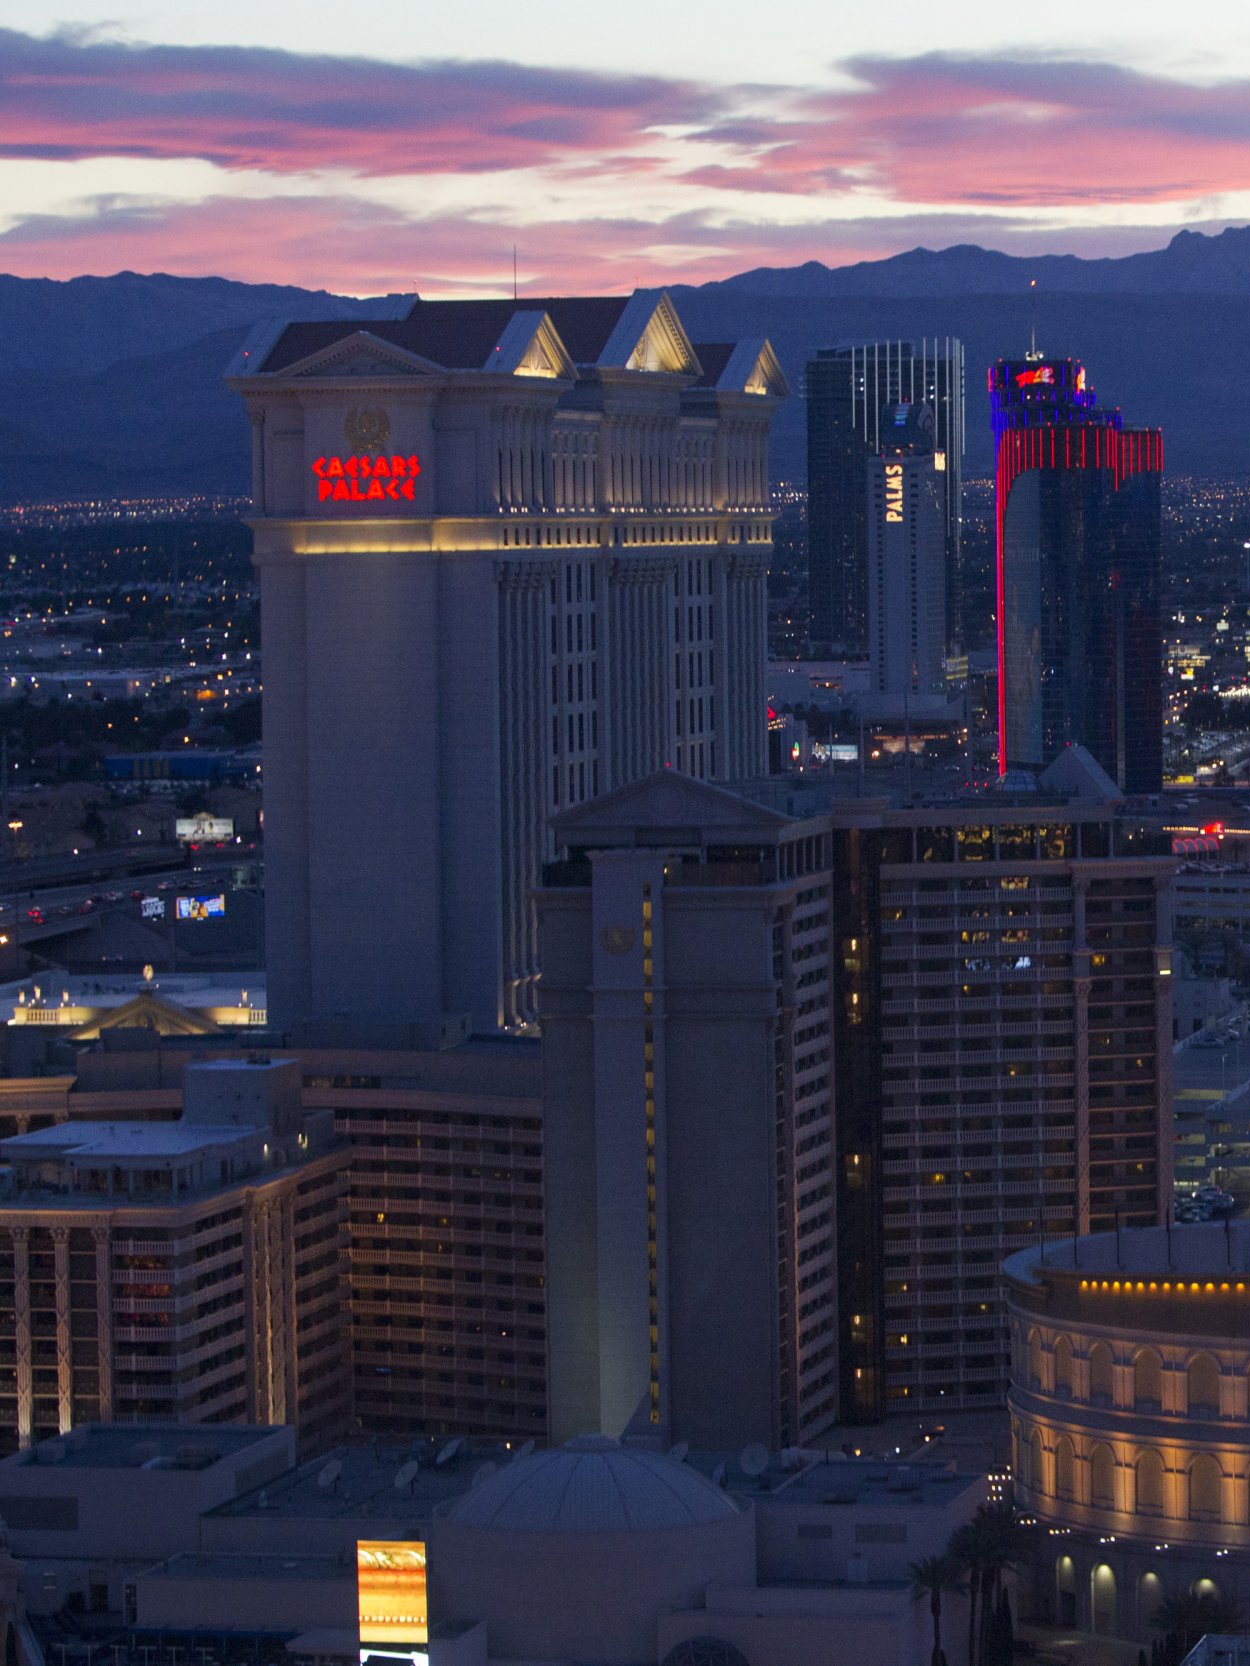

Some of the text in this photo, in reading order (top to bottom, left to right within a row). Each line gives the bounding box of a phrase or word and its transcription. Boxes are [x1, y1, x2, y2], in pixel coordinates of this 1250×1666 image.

[311, 455, 422, 479] CAESARS
[318, 479, 416, 502] PALACE
[885, 464, 903, 523] PALMS
